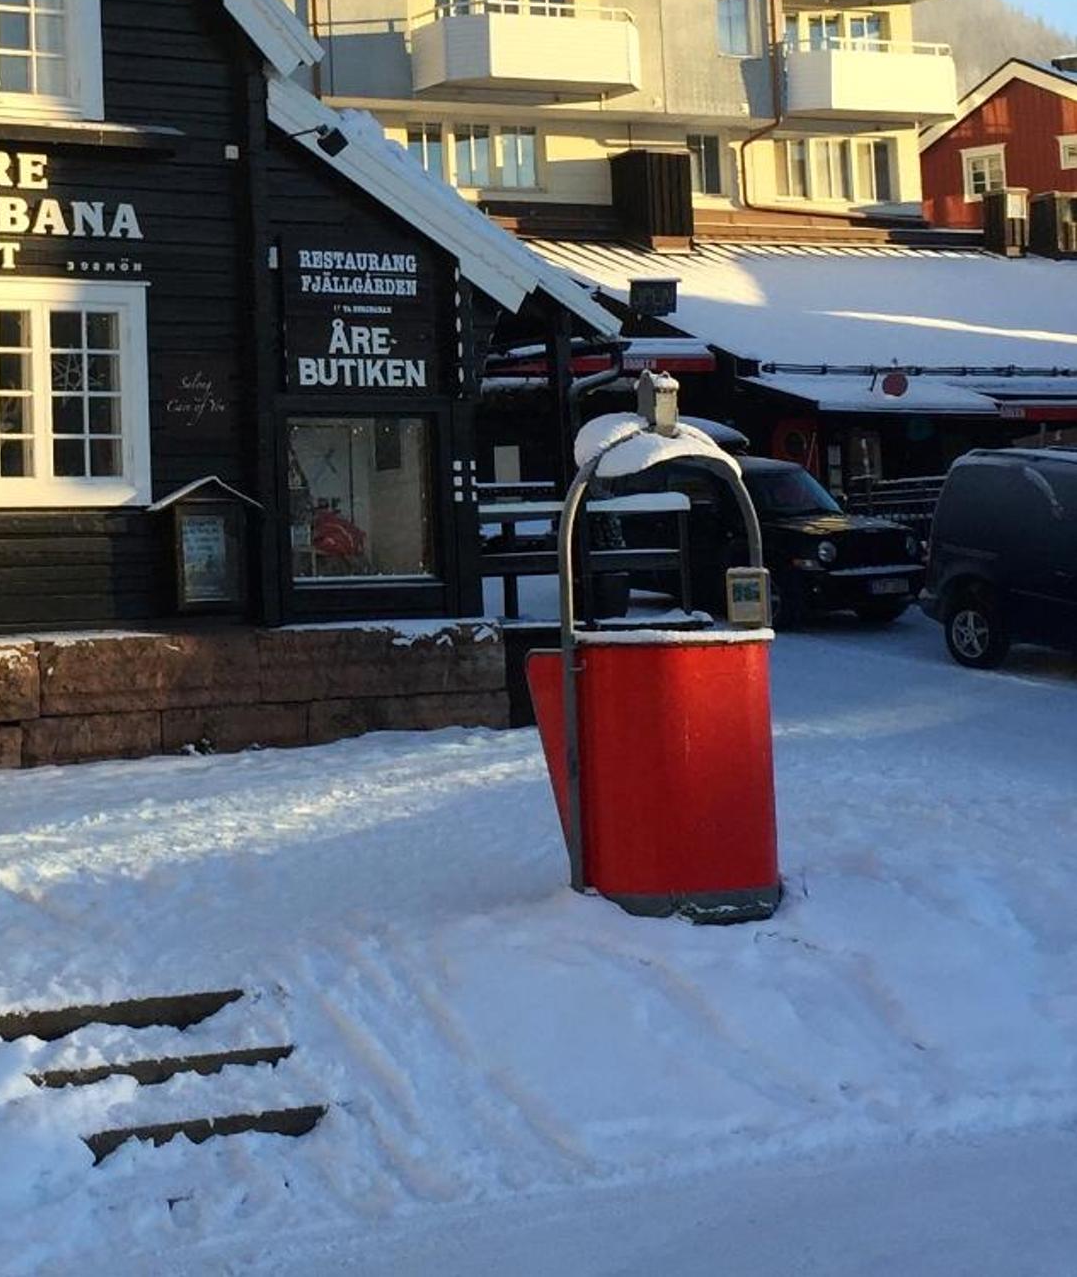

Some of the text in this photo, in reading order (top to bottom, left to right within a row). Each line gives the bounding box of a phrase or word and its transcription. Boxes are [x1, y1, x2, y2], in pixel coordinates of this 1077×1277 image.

[298, 250, 417, 272] RESTAURANG
[301, 272, 417, 296] FJÄLLGÅRDEN
[298, 357, 425, 387] BUTIKEN
